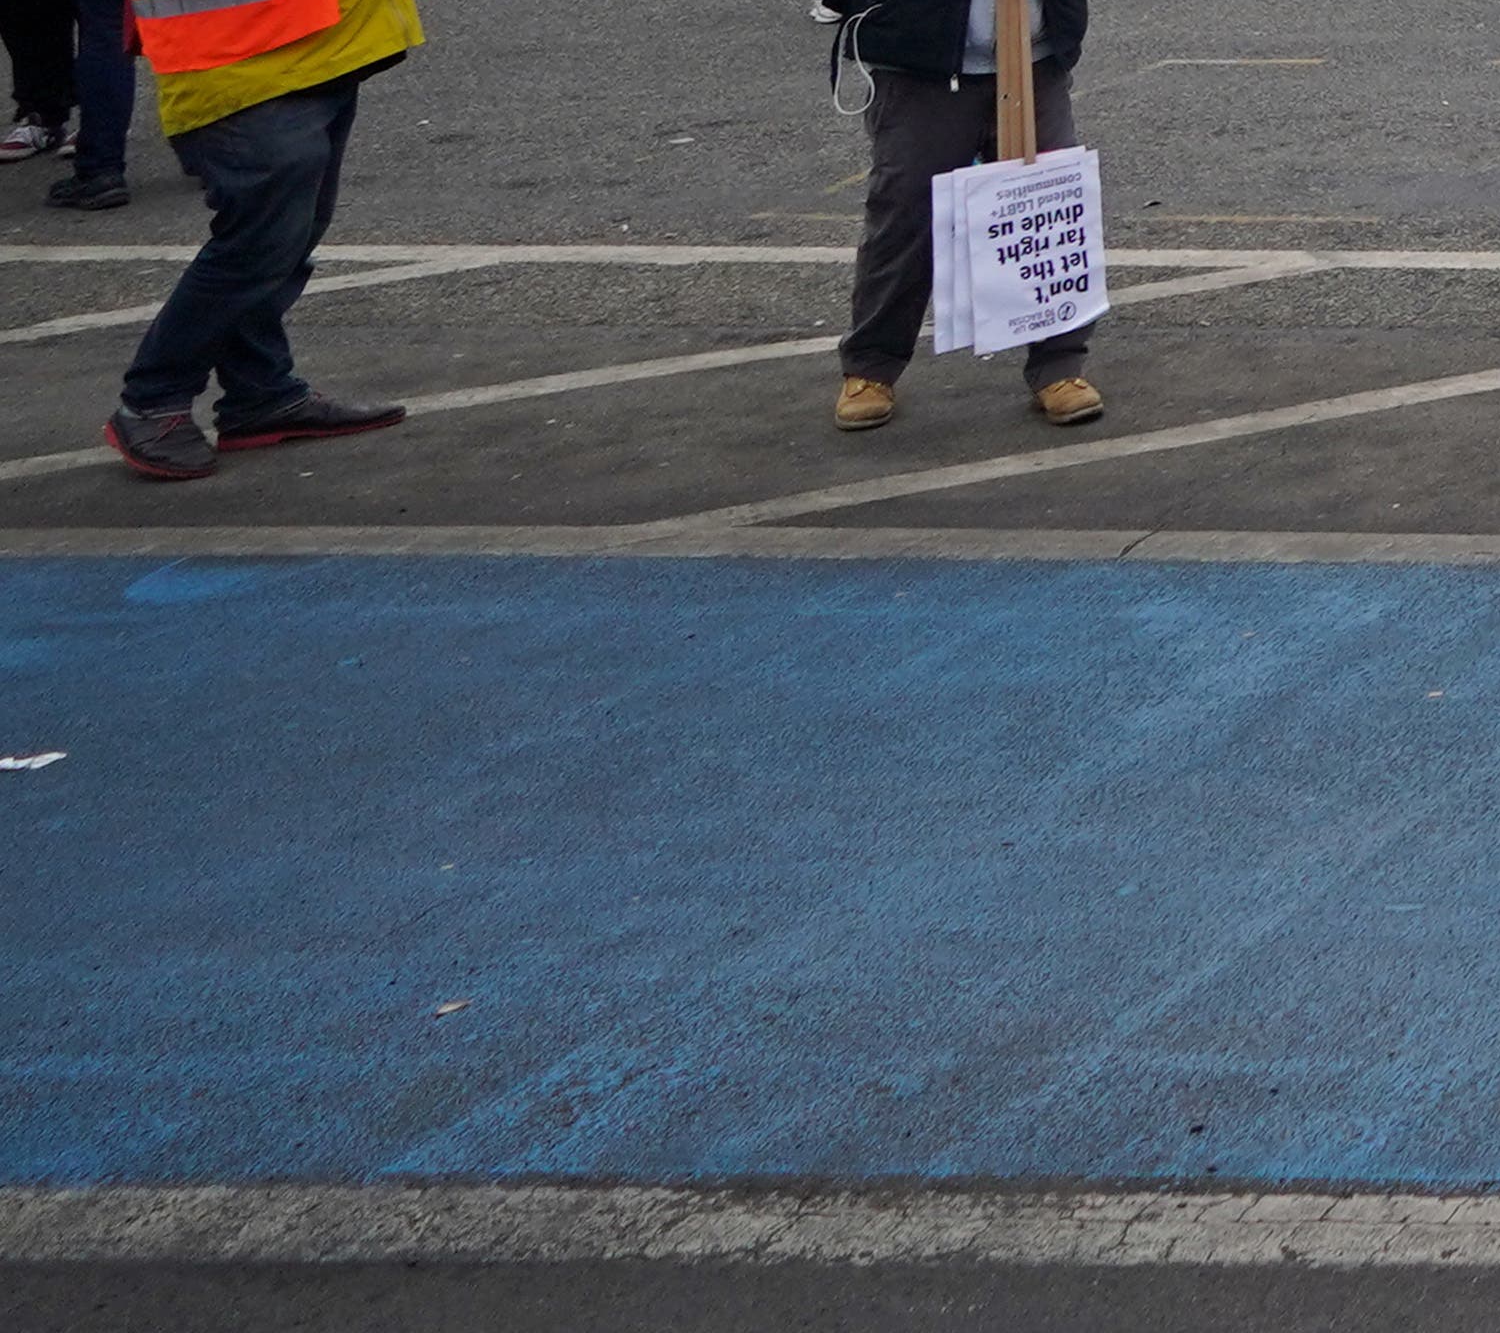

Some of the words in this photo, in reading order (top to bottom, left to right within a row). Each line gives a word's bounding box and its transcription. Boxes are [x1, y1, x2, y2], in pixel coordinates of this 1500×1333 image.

[995, 171, 1083, 201] communities
[1038, 186, 1084, 207] Defend
[991, 200, 1035, 219] LGBT+
[1021, 203, 1084, 231] divide
[987, 223, 1014, 240] us
[1058, 227, 1087, 247] far
[997, 236, 1050, 266] right
[1061, 250, 1089, 274] let
[1019, 259, 1055, 282] the
[1035, 273, 1090, 305] Don't
